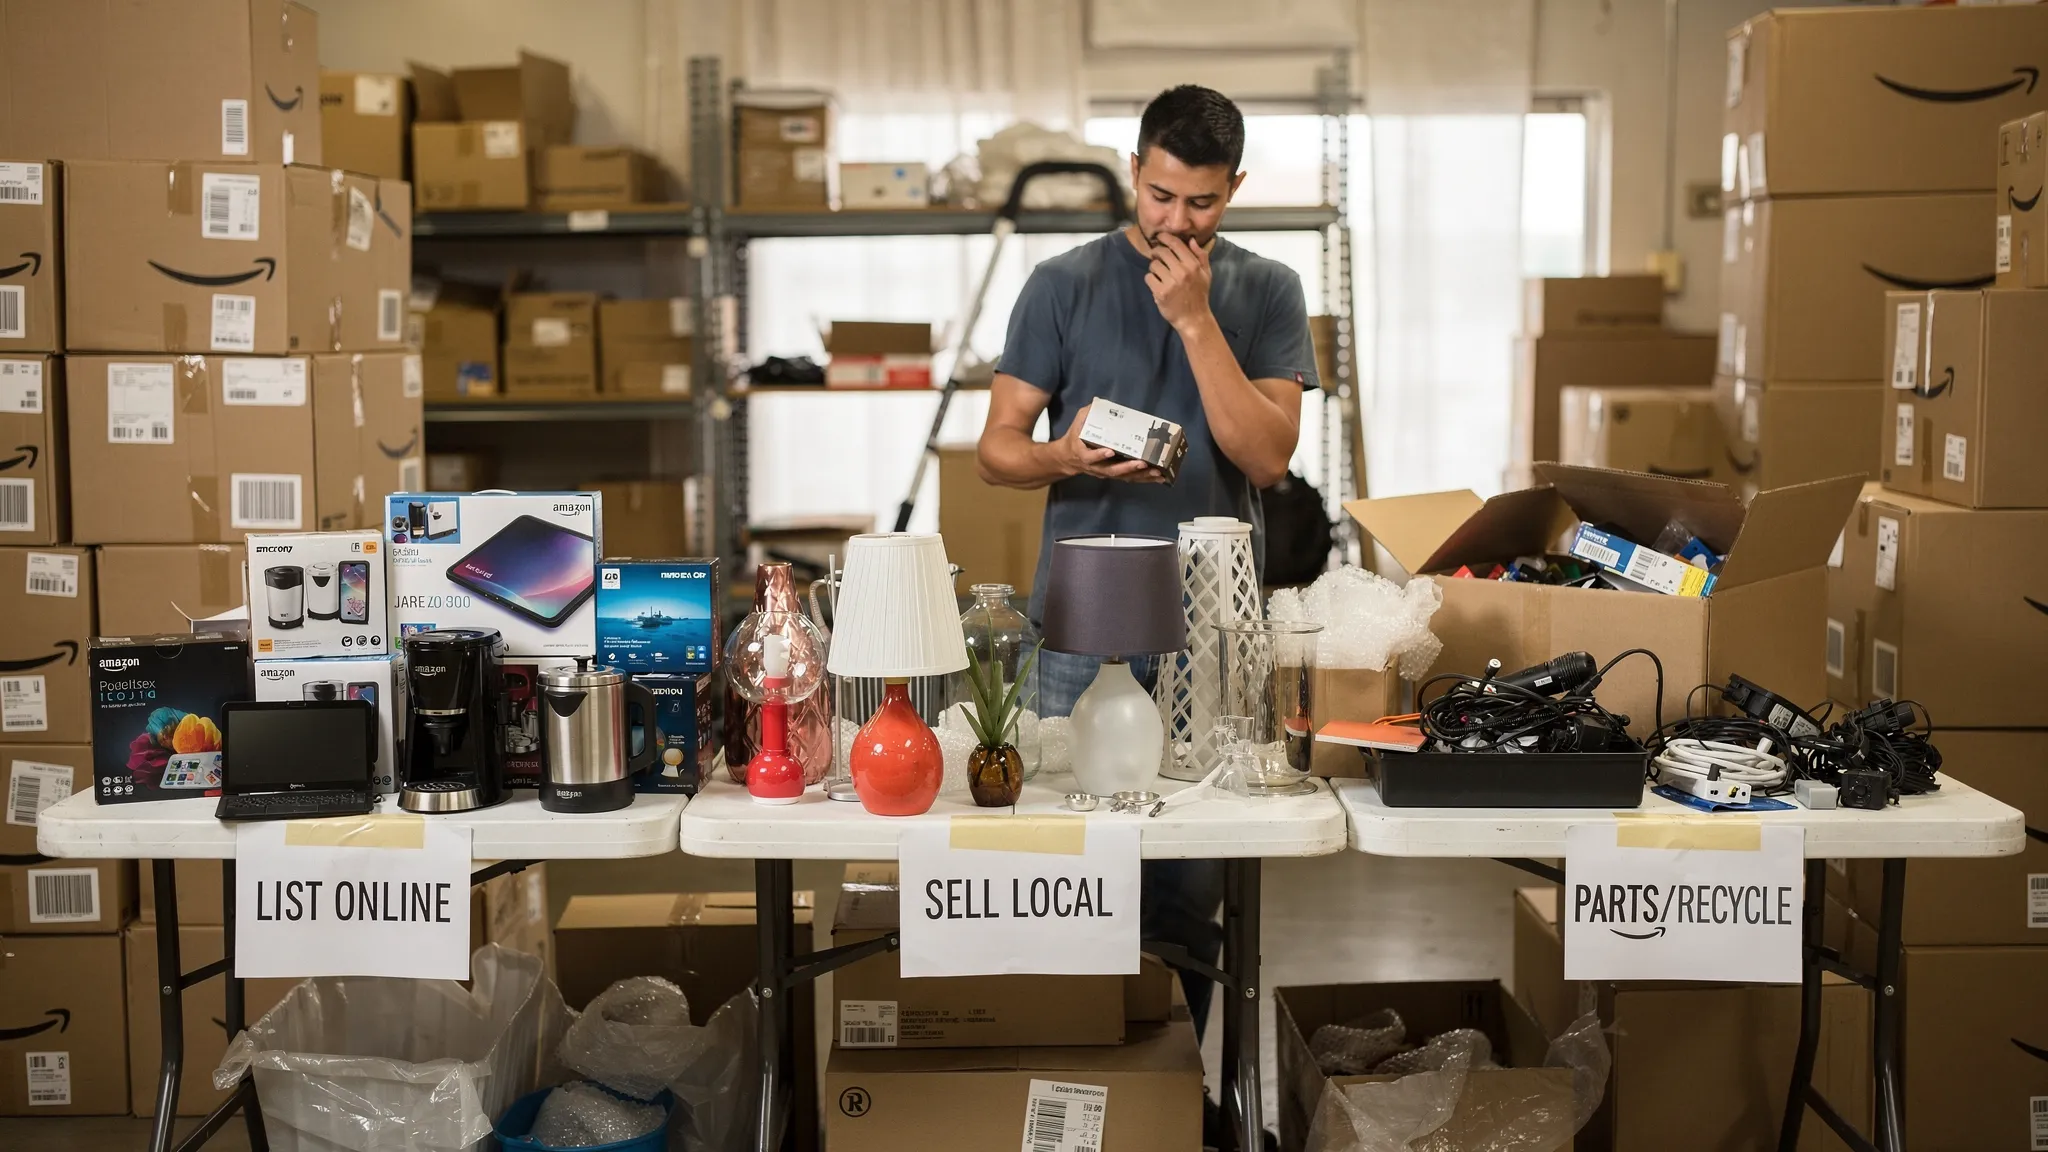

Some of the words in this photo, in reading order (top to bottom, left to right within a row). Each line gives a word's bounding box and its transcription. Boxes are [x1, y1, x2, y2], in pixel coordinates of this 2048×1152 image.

[553, 503, 591, 515] amazon
[394, 595, 426, 609] JARE
[99, 658, 140, 671] amazon
[257, 880, 323, 921] LIST
[335, 880, 452, 923] ONLINE
[925, 878, 999, 920] SELL
[1013, 877, 1113, 918] LOCAL
[1574, 884, 1793, 925] PARTS/RECYCLE
